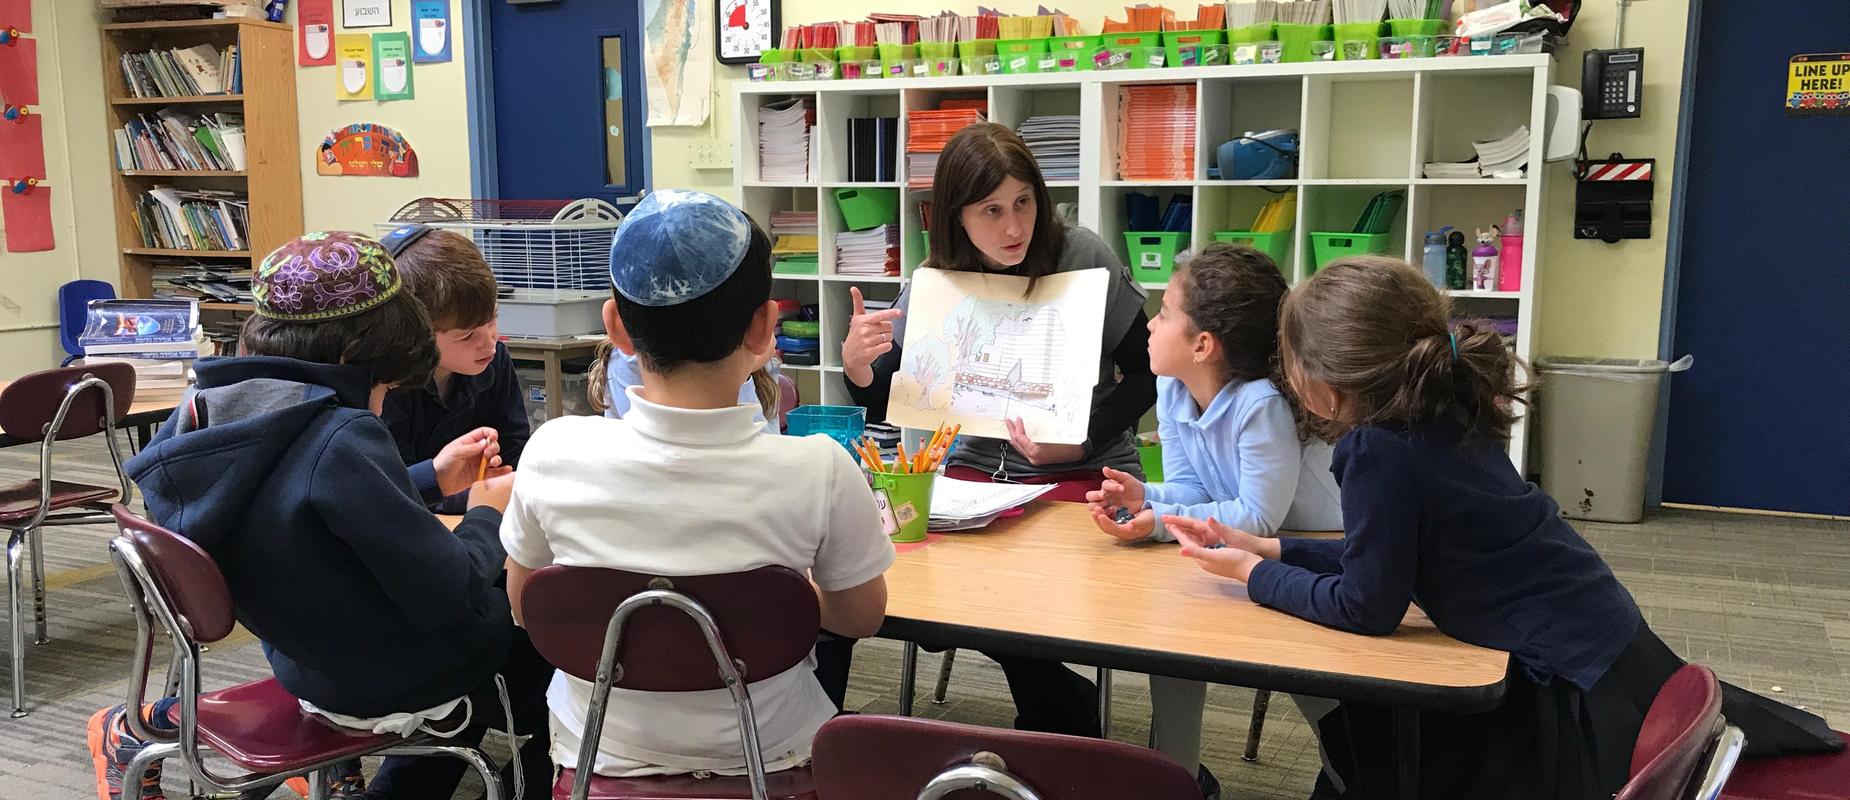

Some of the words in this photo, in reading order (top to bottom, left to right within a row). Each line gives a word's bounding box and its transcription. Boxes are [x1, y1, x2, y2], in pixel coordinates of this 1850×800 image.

[354, 6, 380, 17] השבוע
[760, 8, 768, 16] 50
[761, 33, 768, 41] 40
[1795, 65, 1827, 77] LINE
[1832, 64, 1850, 76] UP
[1801, 78, 1843, 91] HERE!
